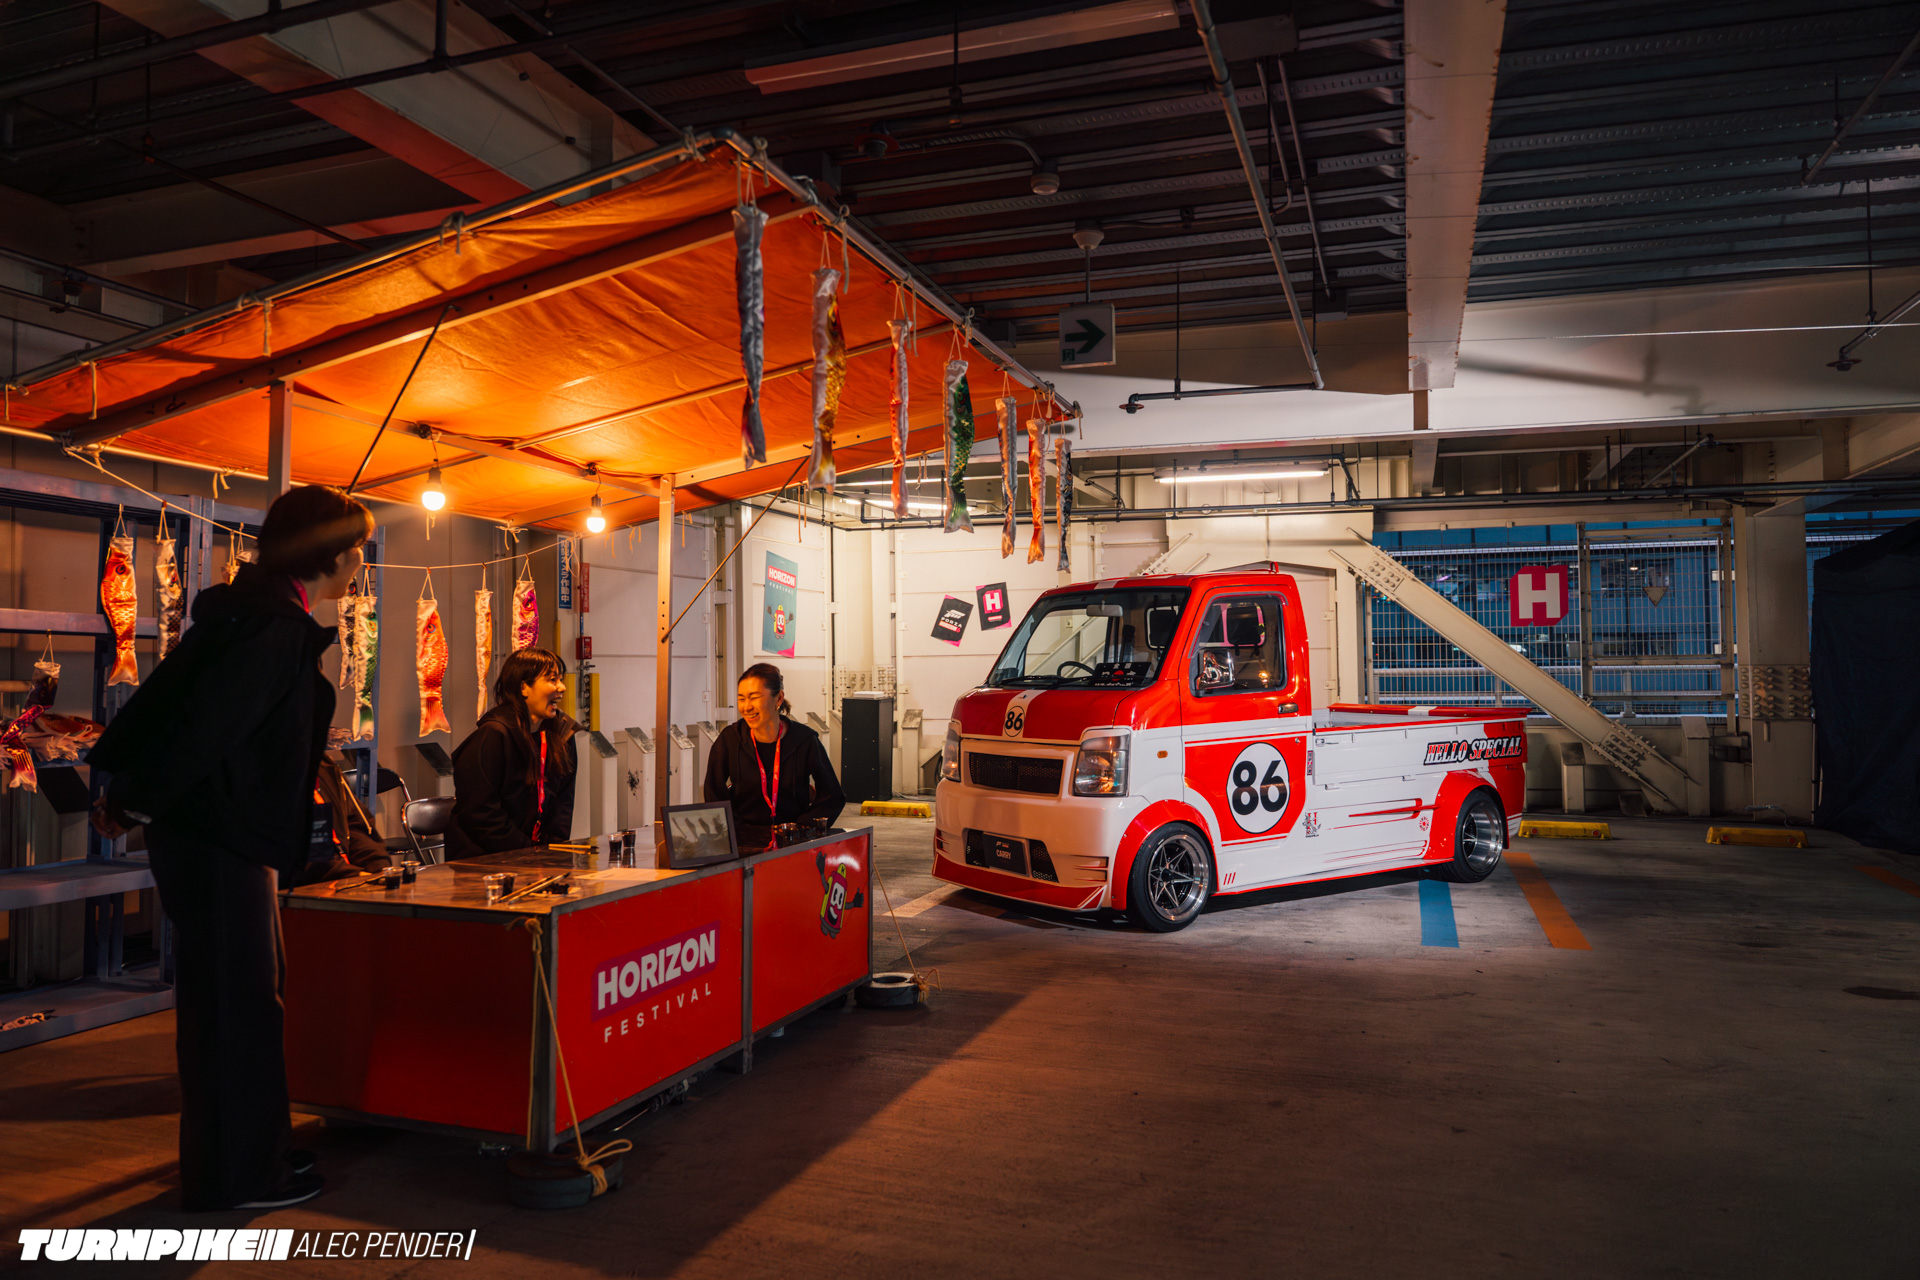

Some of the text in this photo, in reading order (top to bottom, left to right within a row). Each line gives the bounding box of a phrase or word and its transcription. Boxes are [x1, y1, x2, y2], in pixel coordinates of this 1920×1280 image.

[769, 568, 796, 587] HORIZON
[769, 582, 794, 595] FESTIVAL
[985, 592, 1001, 611] H
[1518, 573, 1561, 619] H
[940, 616, 963, 628] FORZA
[1005, 711, 1023, 731] 86
[1424, 737, 1522, 765] HELLO SPECIAL
[1232, 760, 1287, 816] 86
[597, 929, 716, 1011] HORIZON
[604, 983, 712, 1043] FESTIVAL
